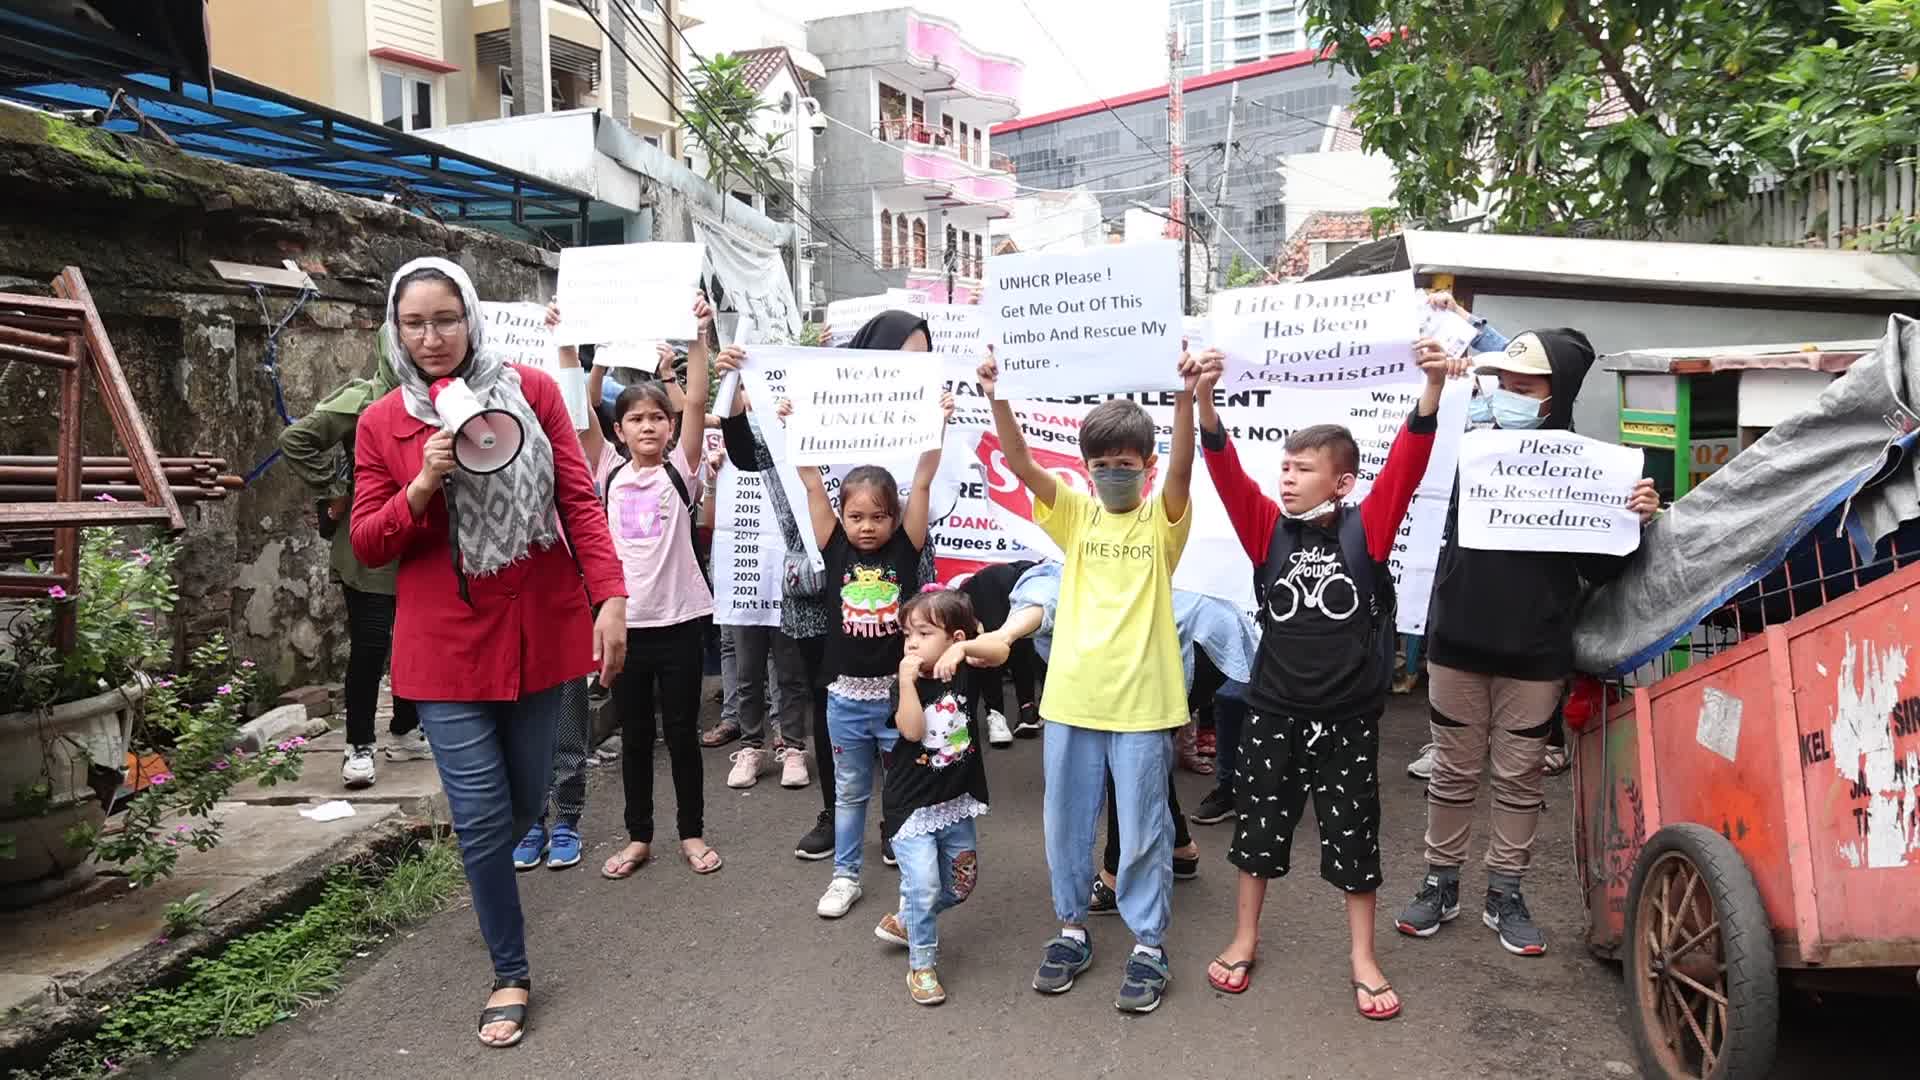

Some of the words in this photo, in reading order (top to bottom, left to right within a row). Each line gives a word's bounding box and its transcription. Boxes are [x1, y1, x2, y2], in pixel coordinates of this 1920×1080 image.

[999, 273, 1050, 291] UNHCR
[1055, 270, 1102, 286] Please
[1001, 303, 1024, 319] Get
[1029, 302, 1052, 316] Me
[1057, 298, 1085, 315] Out
[1089, 296, 1106, 312] Of
[1110, 294, 1142, 310] This
[1234, 297, 1284, 316] Life
[1294, 287, 1396, 311] Danger
[495, 310, 546, 332] Dang
[1264, 321, 1304, 339] Has
[1313, 316, 1368, 335] Been
[1002, 328, 1046, 345] Limbo
[1050, 325, 1079, 343] And
[1083, 323, 1137, 339] Rescue
[1141, 320, 1167, 337] My
[1264, 341, 1343, 367] Proved
[1349, 342, 1371, 357] in
[1004, 355, 1051, 372] Future
[836, 366, 863, 381] We
[867, 365, 901, 380] Are
[1238, 361, 1405, 384] Afghanistan
[812, 389, 884, 406] Human
[888, 385, 923, 402] and
[1371, 391, 1396, 404] We
[820, 411, 894, 427] UNHCR
[901, 410, 917, 425] is
[1350, 407, 1378, 418] and
[1519, 438, 1584, 456] Please
[1490, 460, 1603, 481] Accelerate
[737, 476, 761, 487] 2013
[735, 489, 762, 500] 2014
[1469, 484, 1498, 498] the
[734, 504, 761, 514] 2015
[734, 517, 760, 529] 2016
[1488, 508, 1611, 530] Procedures
[734, 531, 760, 541] 2017
[934, 533, 992, 551] fugees
[996, 538, 1007, 551] &
[734, 544, 759, 554] 2018
[733, 558, 759, 568] 2019
[733, 572, 761, 582] 2020
[733, 586, 757, 596] 2021
[733, 599, 758, 610] Isn't
[761, 599, 771, 609] it
